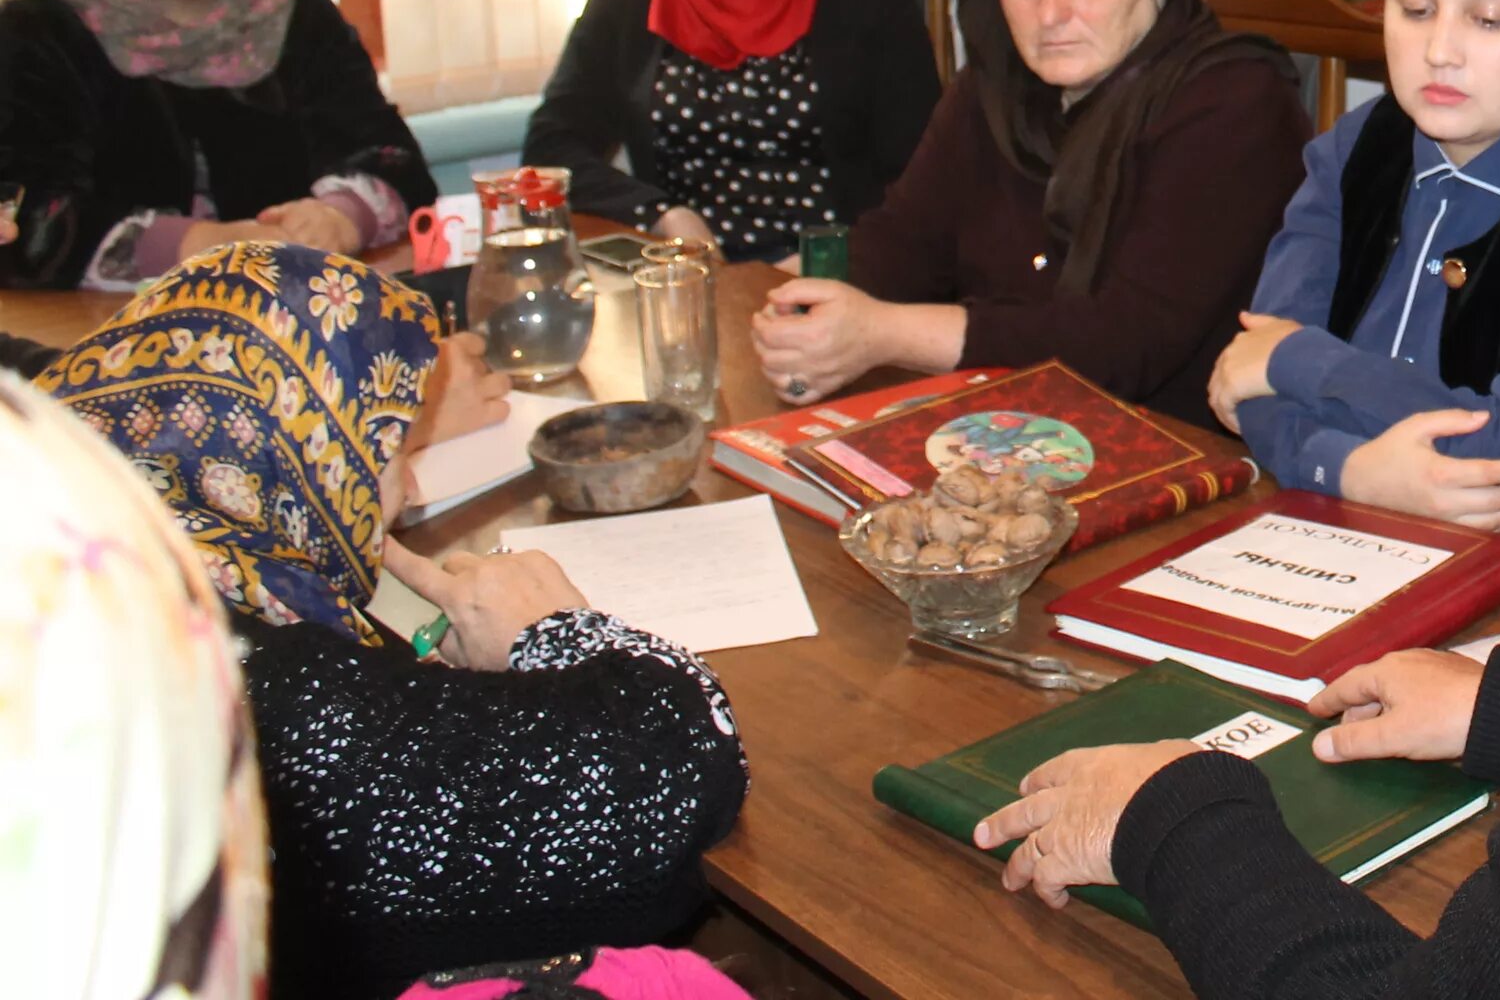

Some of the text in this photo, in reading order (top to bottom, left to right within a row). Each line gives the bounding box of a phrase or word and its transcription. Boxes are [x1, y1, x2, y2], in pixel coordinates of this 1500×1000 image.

[1234, 551, 1357, 585] СИЛЬНЫ
[1230, 586, 1321, 612] ДРУЖБОЙ
[1205, 718, 1272, 750] КОЕ
